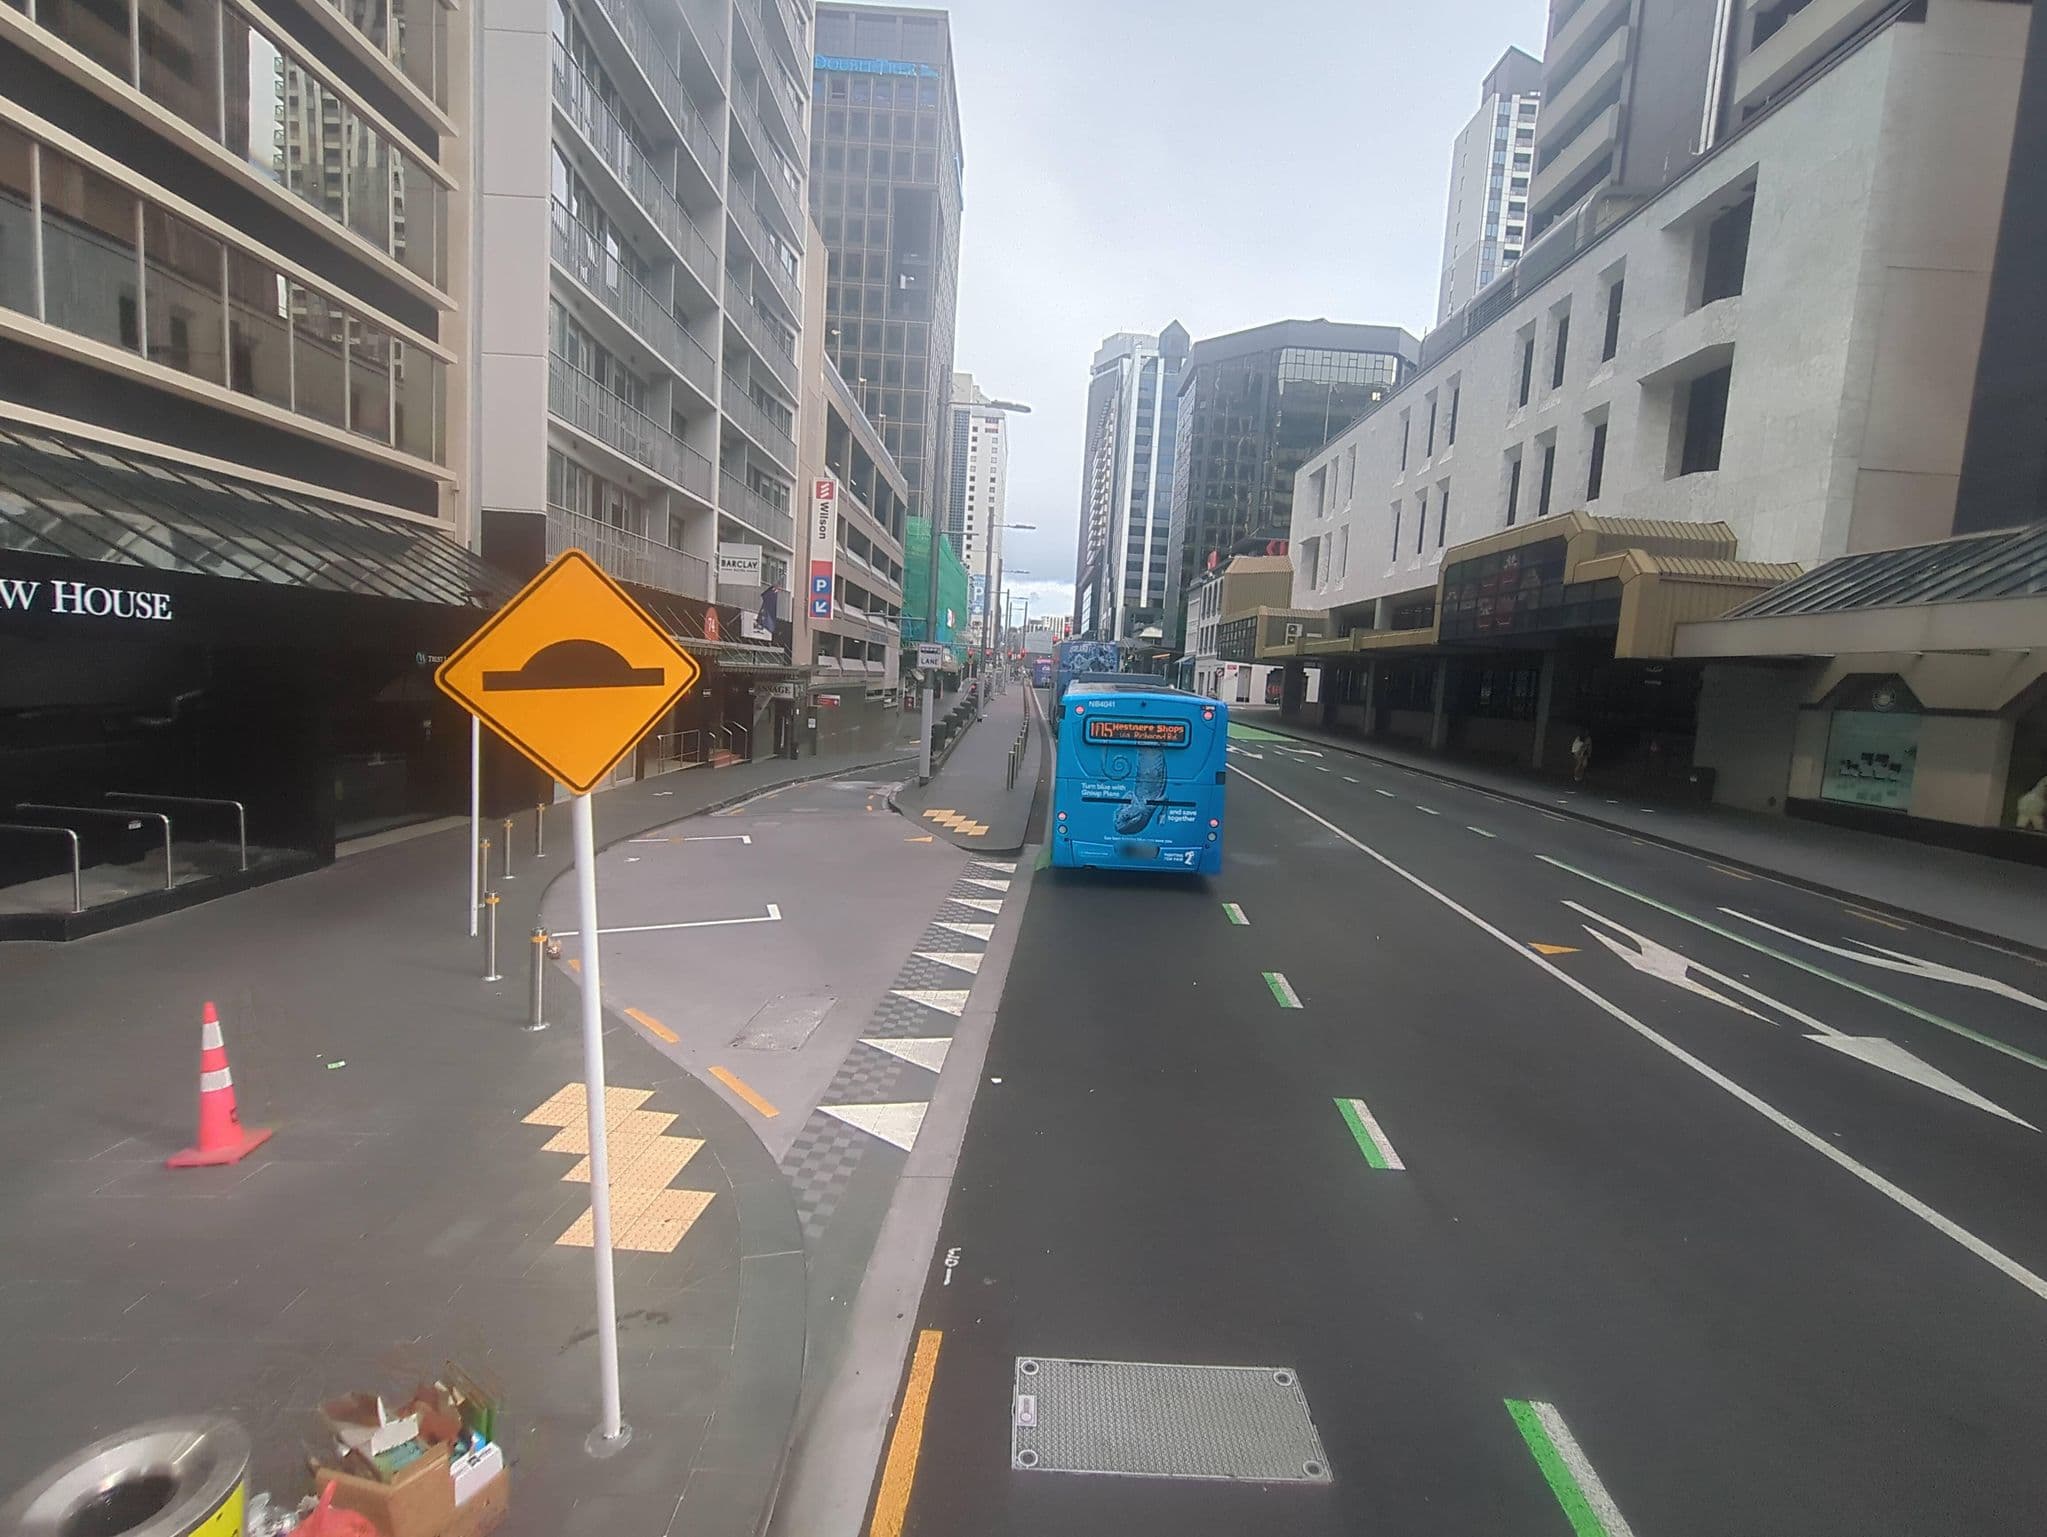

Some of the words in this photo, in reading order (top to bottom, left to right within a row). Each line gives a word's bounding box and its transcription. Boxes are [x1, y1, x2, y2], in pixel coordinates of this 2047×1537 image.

[818, 502, 829, 540] Wilson
[721, 559, 758, 569] BARCLAY
[816, 579, 828, 592] P
[0, 579, 42, 611] W
[51, 580, 173, 621] HOUSE
[921, 657, 938, 666] LANE
[1088, 700, 1116, 708] NB4041
[1157, 724, 1184, 734] Shops
[1081, 782, 1096, 790] Turn
[1097, 783, 1111, 791] blue
[1168, 815, 1196, 823] together
